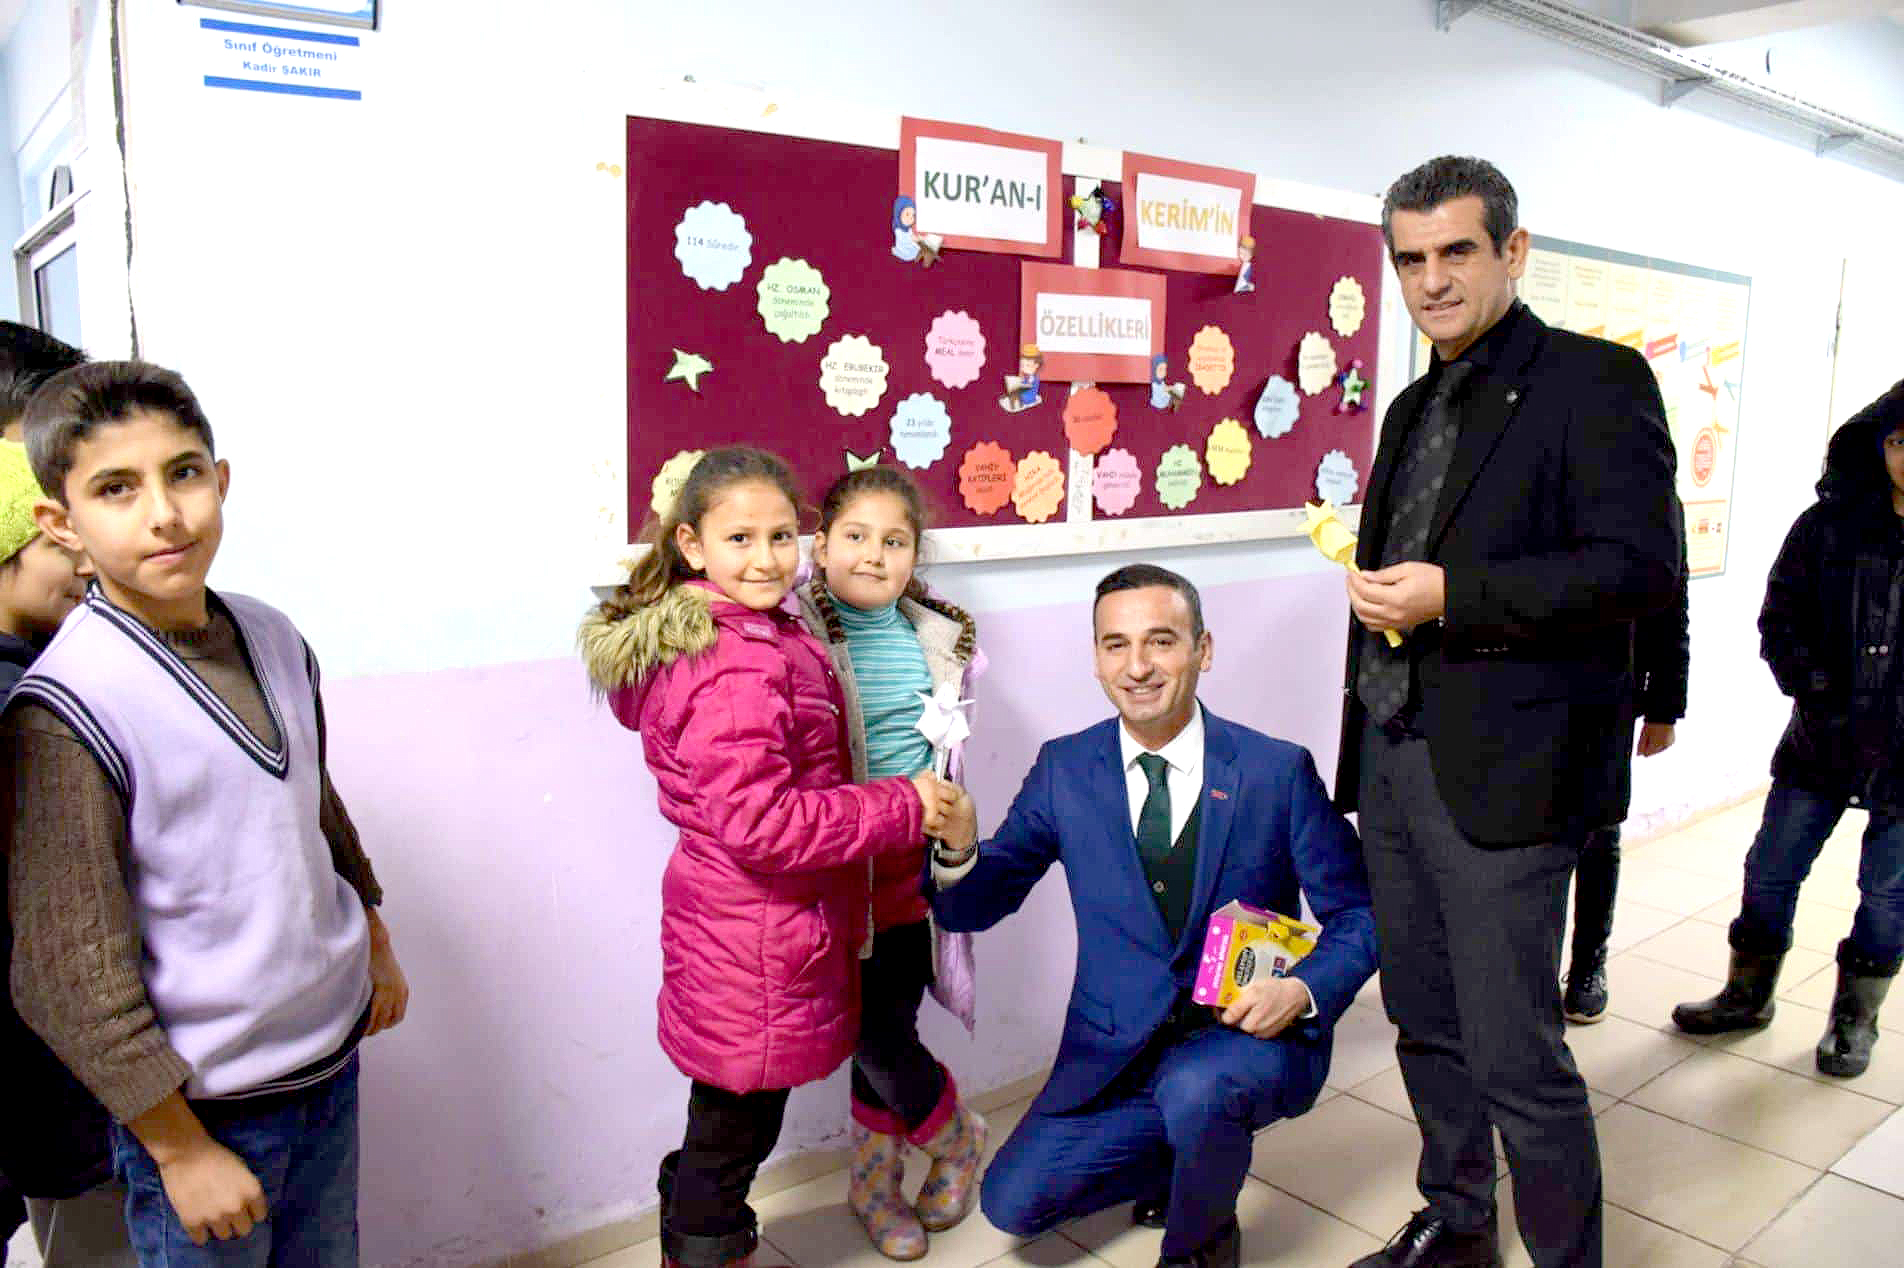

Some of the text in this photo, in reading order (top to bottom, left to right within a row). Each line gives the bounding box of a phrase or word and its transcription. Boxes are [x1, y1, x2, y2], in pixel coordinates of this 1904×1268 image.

[224, 38, 337, 61] Sınıf Öğretmeni
[243, 60, 277, 73] Kadir
[924, 170, 1042, 211] KUR'AN-I
[1141, 198, 1234, 236] KERİM'İN
[1040, 307, 1149, 341] ÖZELLİKLERİ
